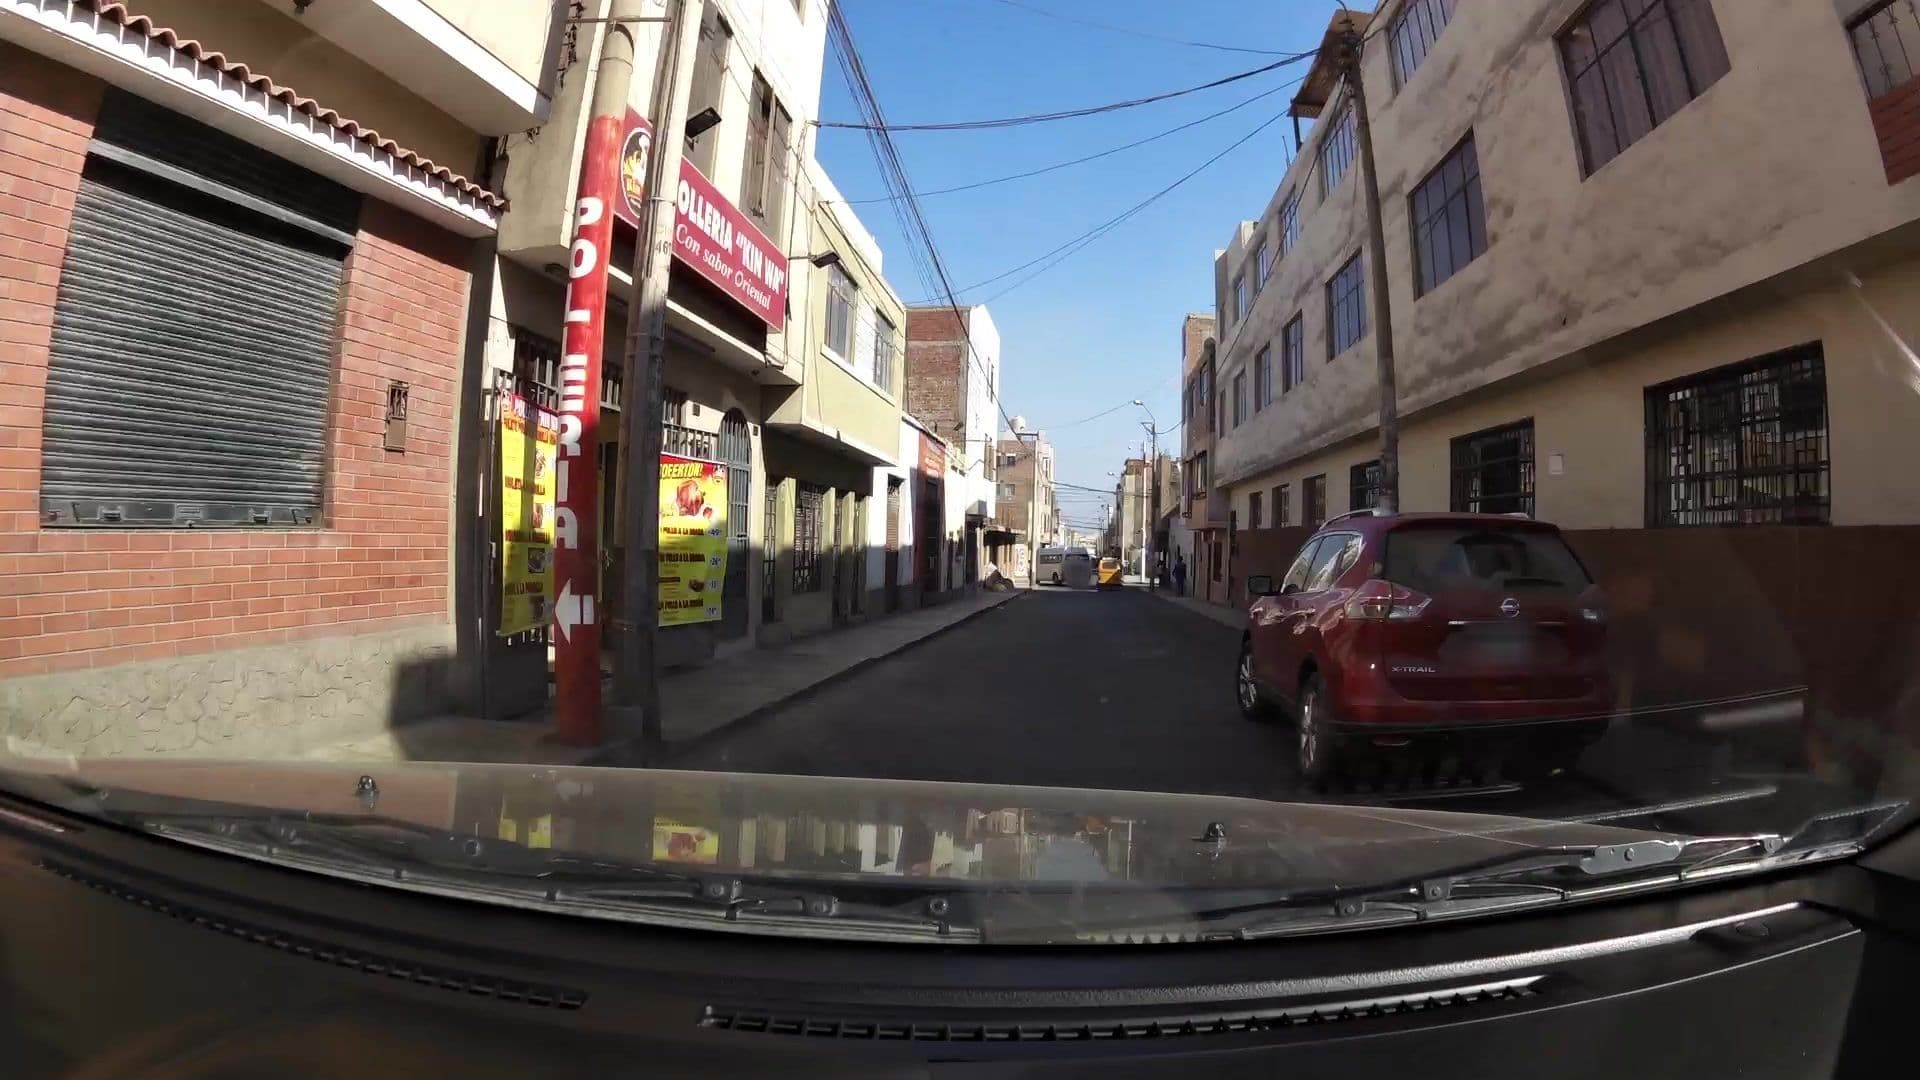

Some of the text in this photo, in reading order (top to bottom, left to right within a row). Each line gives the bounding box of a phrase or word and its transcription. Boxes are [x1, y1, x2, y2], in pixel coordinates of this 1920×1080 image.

[677, 179, 733, 256] OLLERIA
[676, 223, 771, 310] Con sabor Oriental
